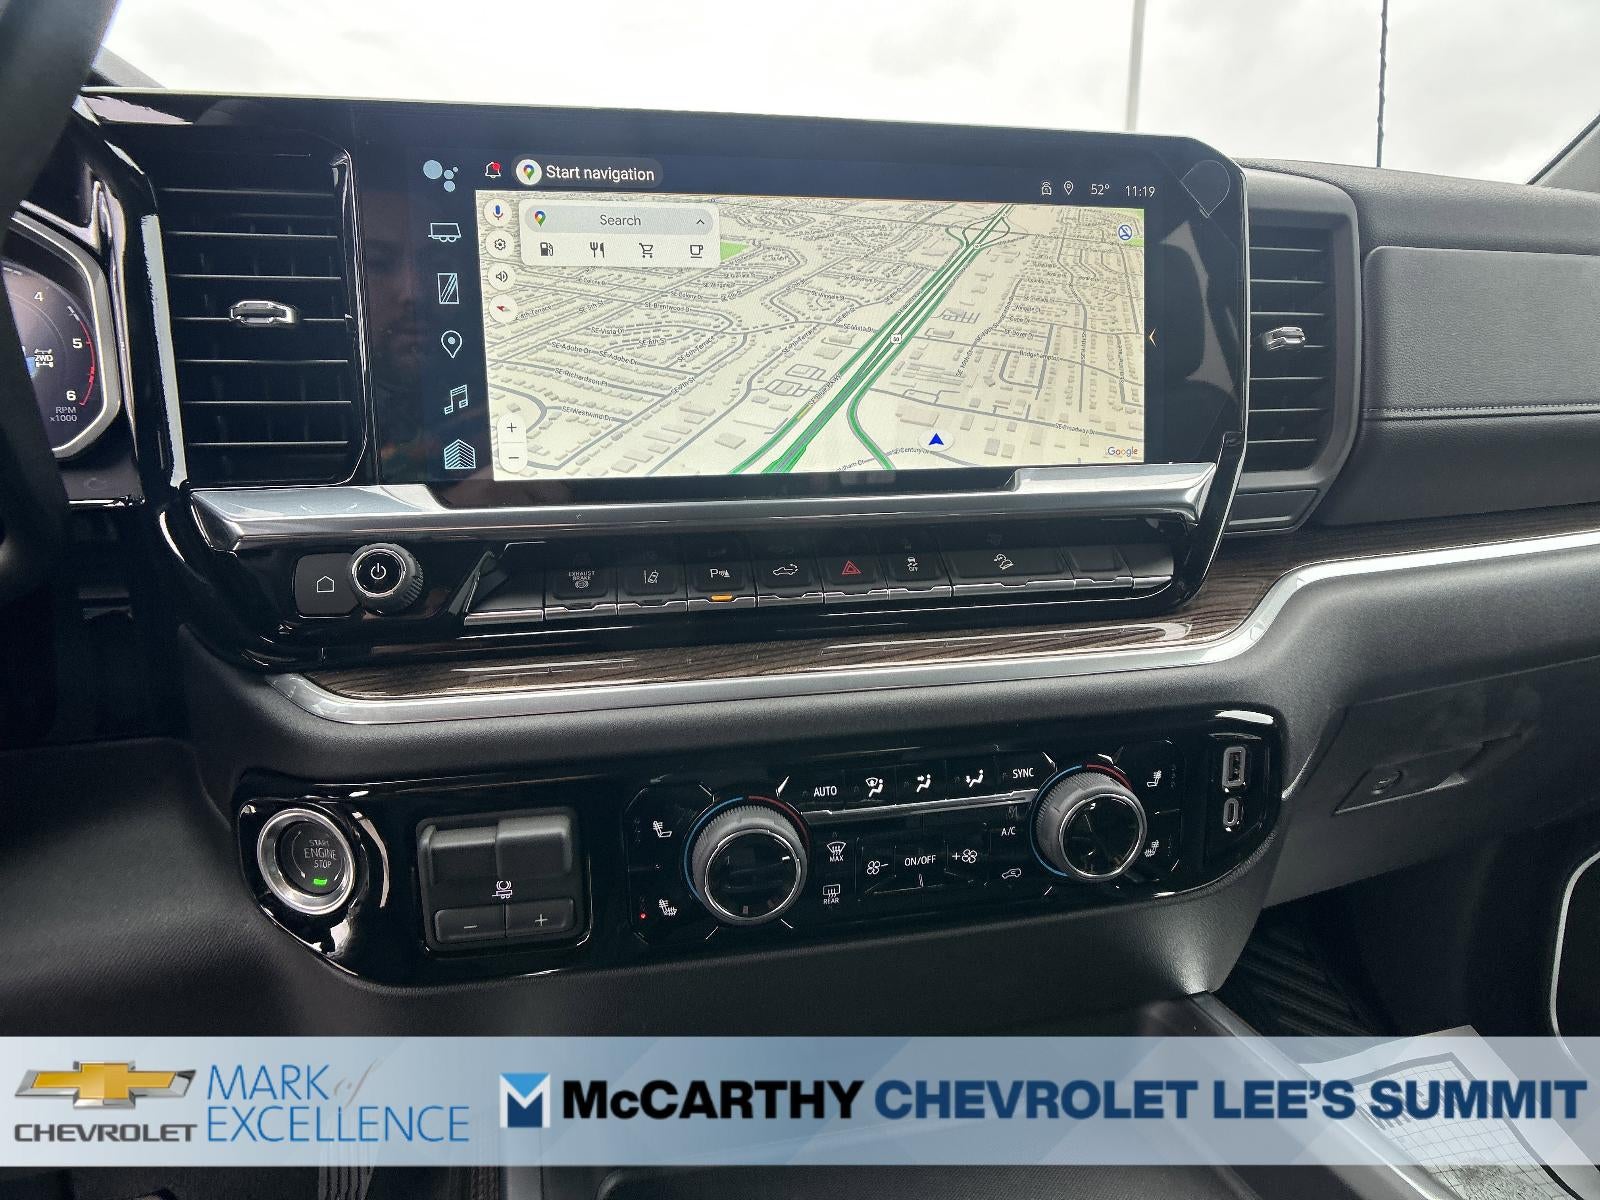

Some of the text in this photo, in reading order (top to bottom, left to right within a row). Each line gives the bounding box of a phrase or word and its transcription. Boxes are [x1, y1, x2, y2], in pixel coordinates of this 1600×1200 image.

[546, 164, 655, 183] Start navigation
[1125, 185, 1156, 197] 11:19
[599, 213, 642, 227] Search
[34, 291, 44, 301] 4
[72, 338, 83, 349] 5
[562, 343, 583, 353] Adobe
[695, 335, 715, 351] Terrace
[34, 354, 54, 362] 2WD
[609, 354, 630, 363] Adobe
[564, 370, 601, 385] Richardson
[66, 390, 77, 401] 6
[55, 406, 77, 414] RPM
[572, 408, 604, 420] Westwind
[50, 414, 78, 422] x1000
[1107, 446, 1138, 457] Google
[1012, 768, 1035, 779] SYNC
[813, 785, 838, 798] AUTO
[1001, 827, 1016, 836] A/C
[304, 847, 337, 860] ENGINE
[829, 854, 844, 862] MAX
[313, 859, 332, 869] STOP
[904, 854, 937, 868] ON/OFF
[823, 896, 840, 905] REAR
